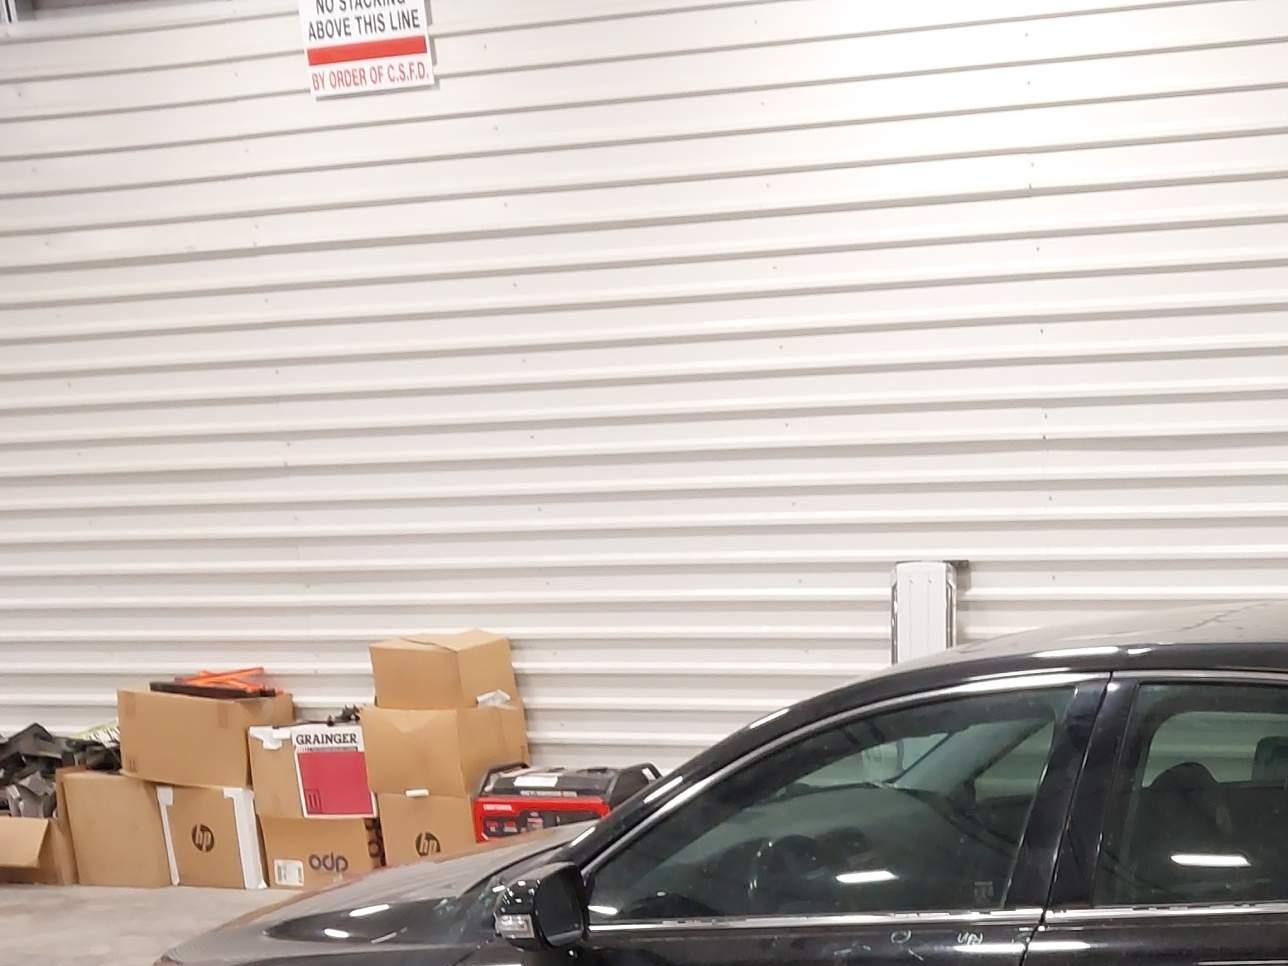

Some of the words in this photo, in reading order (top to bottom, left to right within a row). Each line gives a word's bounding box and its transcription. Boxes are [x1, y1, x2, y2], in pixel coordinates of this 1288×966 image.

[315, 0, 335, 15] NO
[308, 18, 351, 40] ABOVE
[355, 13, 386, 35] THIS
[389, 9, 420, 31] LINE
[312, 72, 326, 91] BY
[329, 67, 367, 89] ORDER
[369, 64, 386, 84] OF
[387, 62, 430, 83] C.S.F.D.
[296, 733, 357, 745] GRAINGER
[192, 823, 215, 851] hp
[309, 852, 349, 872] odp
